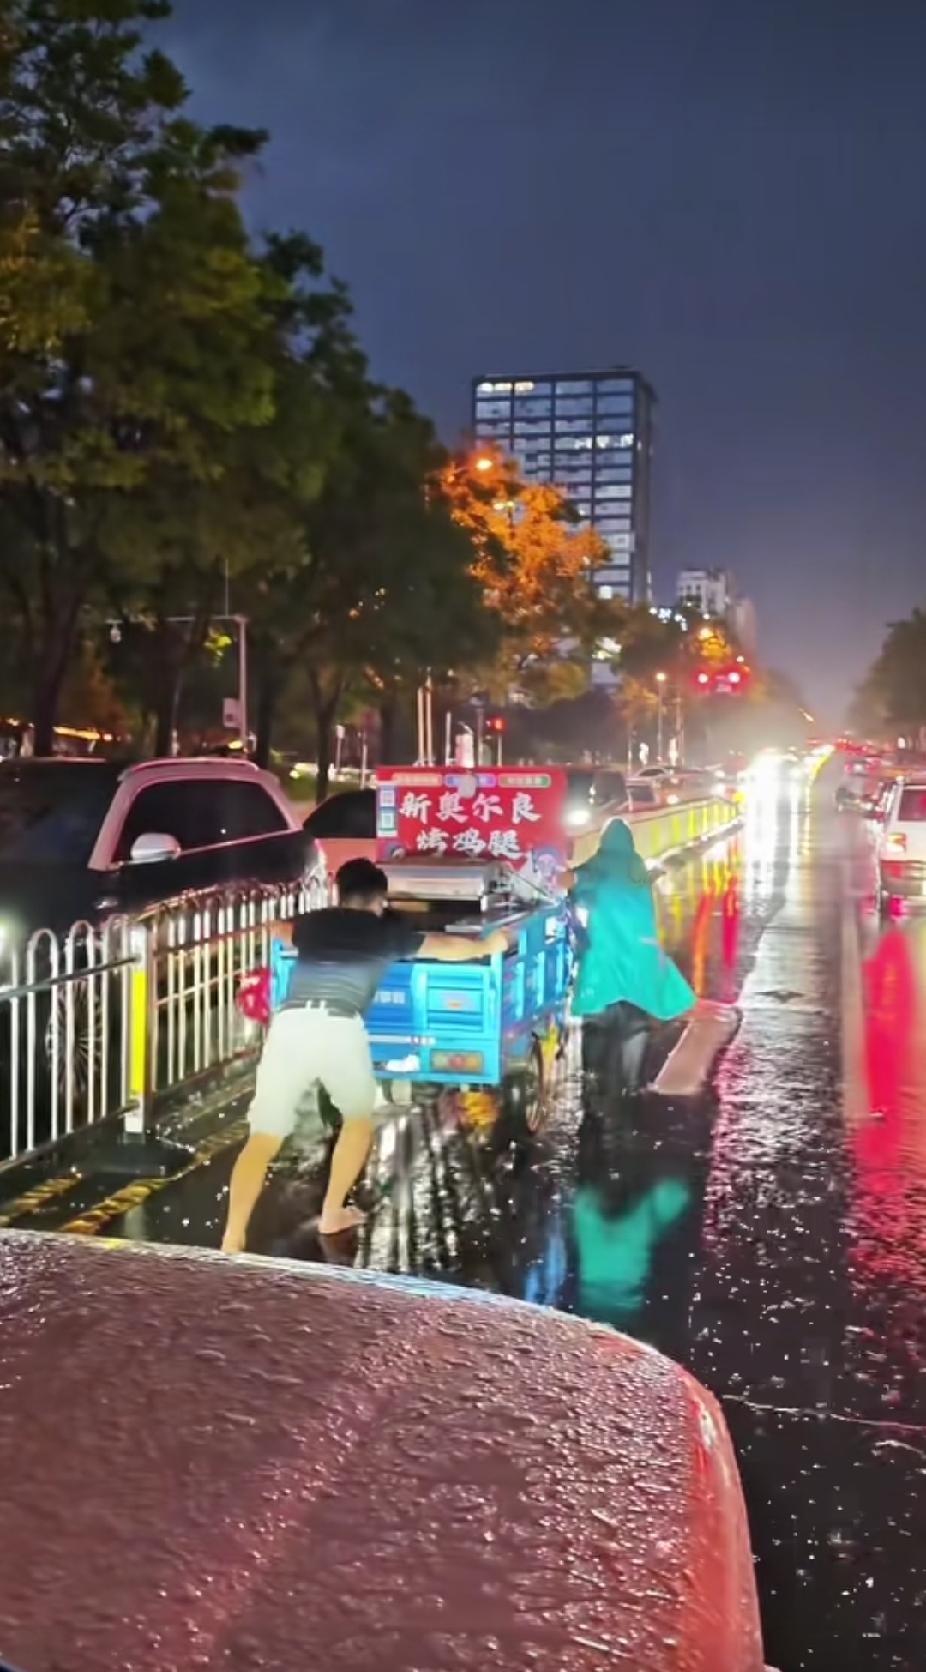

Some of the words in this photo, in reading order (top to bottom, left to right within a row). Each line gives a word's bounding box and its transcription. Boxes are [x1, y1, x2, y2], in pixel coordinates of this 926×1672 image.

[400, 791, 541, 824] 新奥尔良
[416, 827, 524, 859] 烤鸡腿
